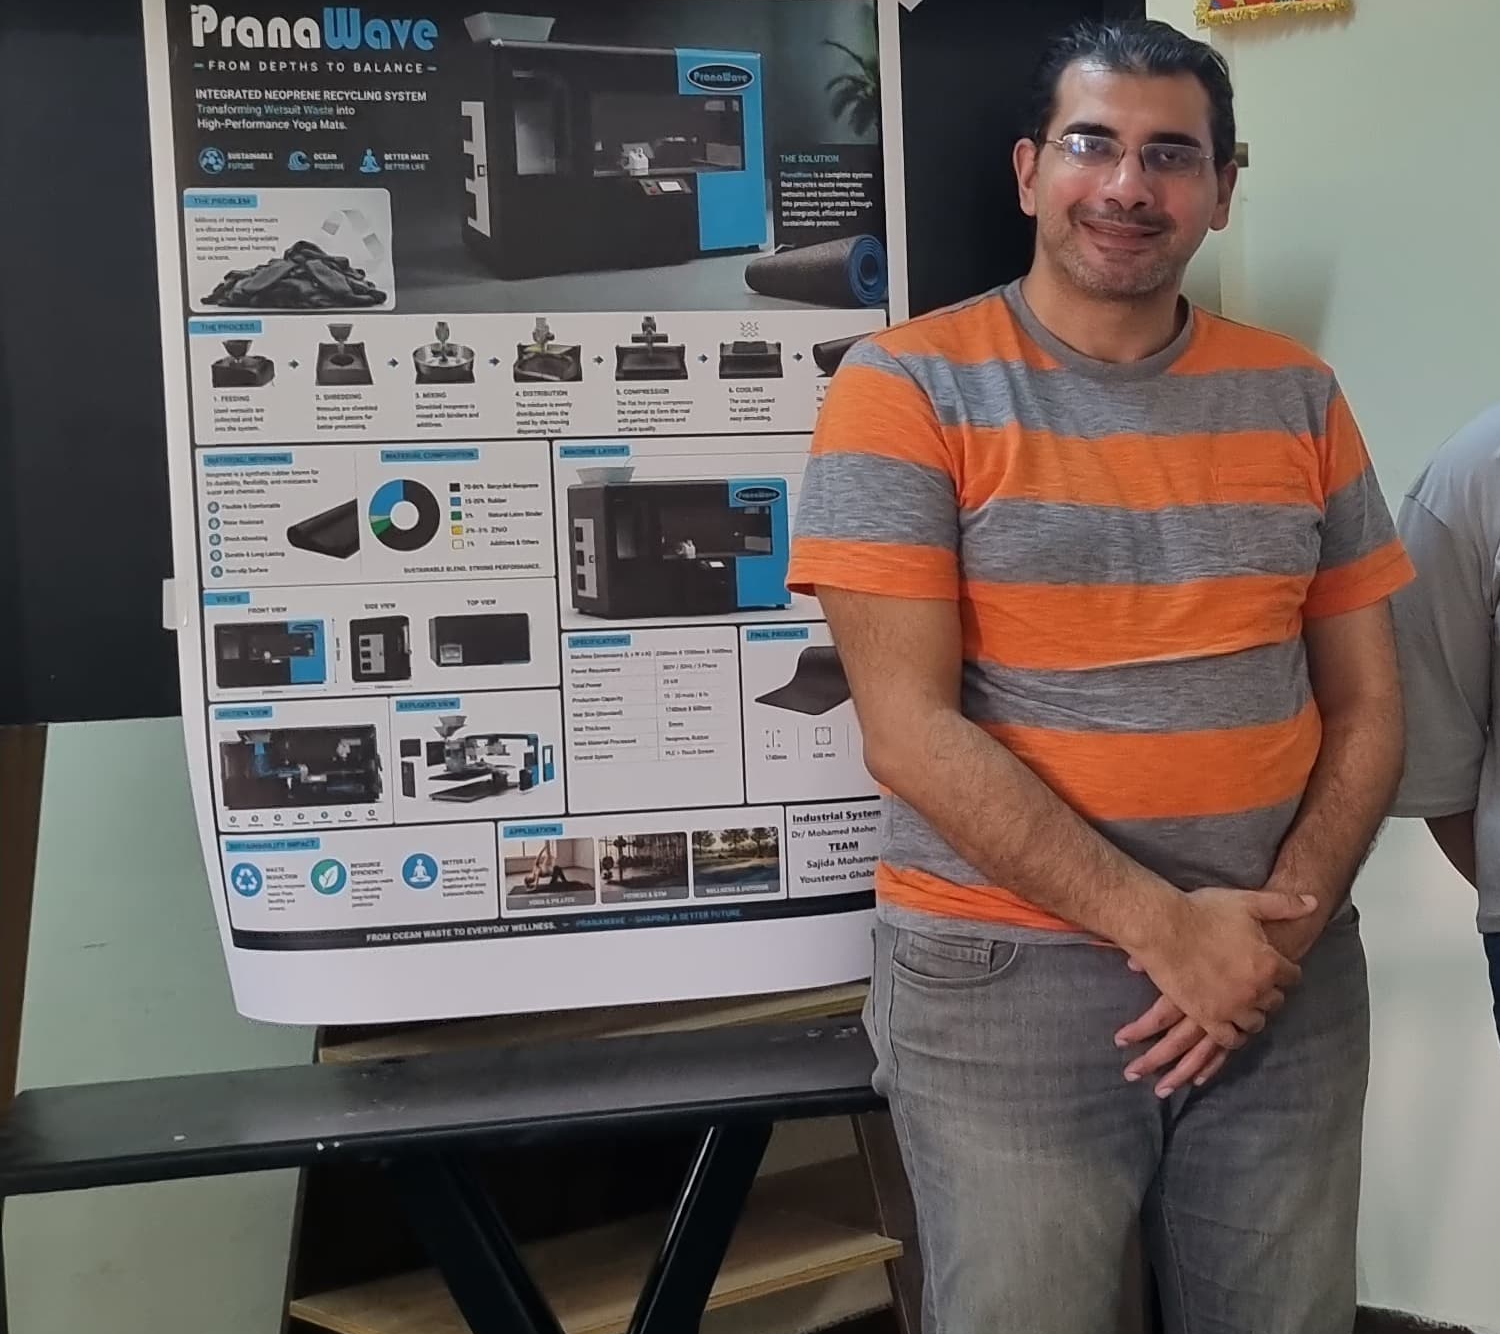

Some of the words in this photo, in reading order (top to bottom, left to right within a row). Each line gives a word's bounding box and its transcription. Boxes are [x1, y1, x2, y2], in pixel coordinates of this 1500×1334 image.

[190, 4, 438, 51] PranaWave
[208, 60, 251, 72] FROM
[259, 61, 319, 72] DEPTHS
[326, 62, 345, 73] TO
[353, 63, 423, 74] BALANCE
[195, 89, 262, 100] INTEGRATED
[264, 90, 321, 101] NEOPRENE
[323, 90, 382, 101] RECYCLING
[384, 91, 427, 102] SYSTEM
[196, 104, 262, 117] Transforming
[264, 105, 301, 115] Wetsuit
[303, 105, 333, 115] Waste
[336, 105, 356, 115] into
[197, 118, 290, 131] High-Performance
[291, 119, 318, 132] Yoga
[320, 120, 347, 130] Mats.
[313, 153, 338, 161] OCEAN
[780, 155, 796, 163] THE
[798, 155, 839, 163] SOLUTION
[467, 599, 479, 607] TOP
[792, 811, 843, 823] Industrial
[846, 810, 881, 821] System
[792, 830, 806, 839] Dr/
[808, 827, 850, 837] Mohamed
[829, 841, 858, 852] TEAM
[806, 859, 835, 870] Sajida
[838, 855, 878, 865] Mohame
[800, 873, 846, 884] Yousteena
[366, 934, 392, 942] FROM
[393, 931, 422, 940] OCEAN
[424, 929, 452, 939] WASTE
[454, 927, 466, 936] TO
[467, 925, 510, 935] EVERYDAY
[512, 921, 557, 932] WELLNESS.
